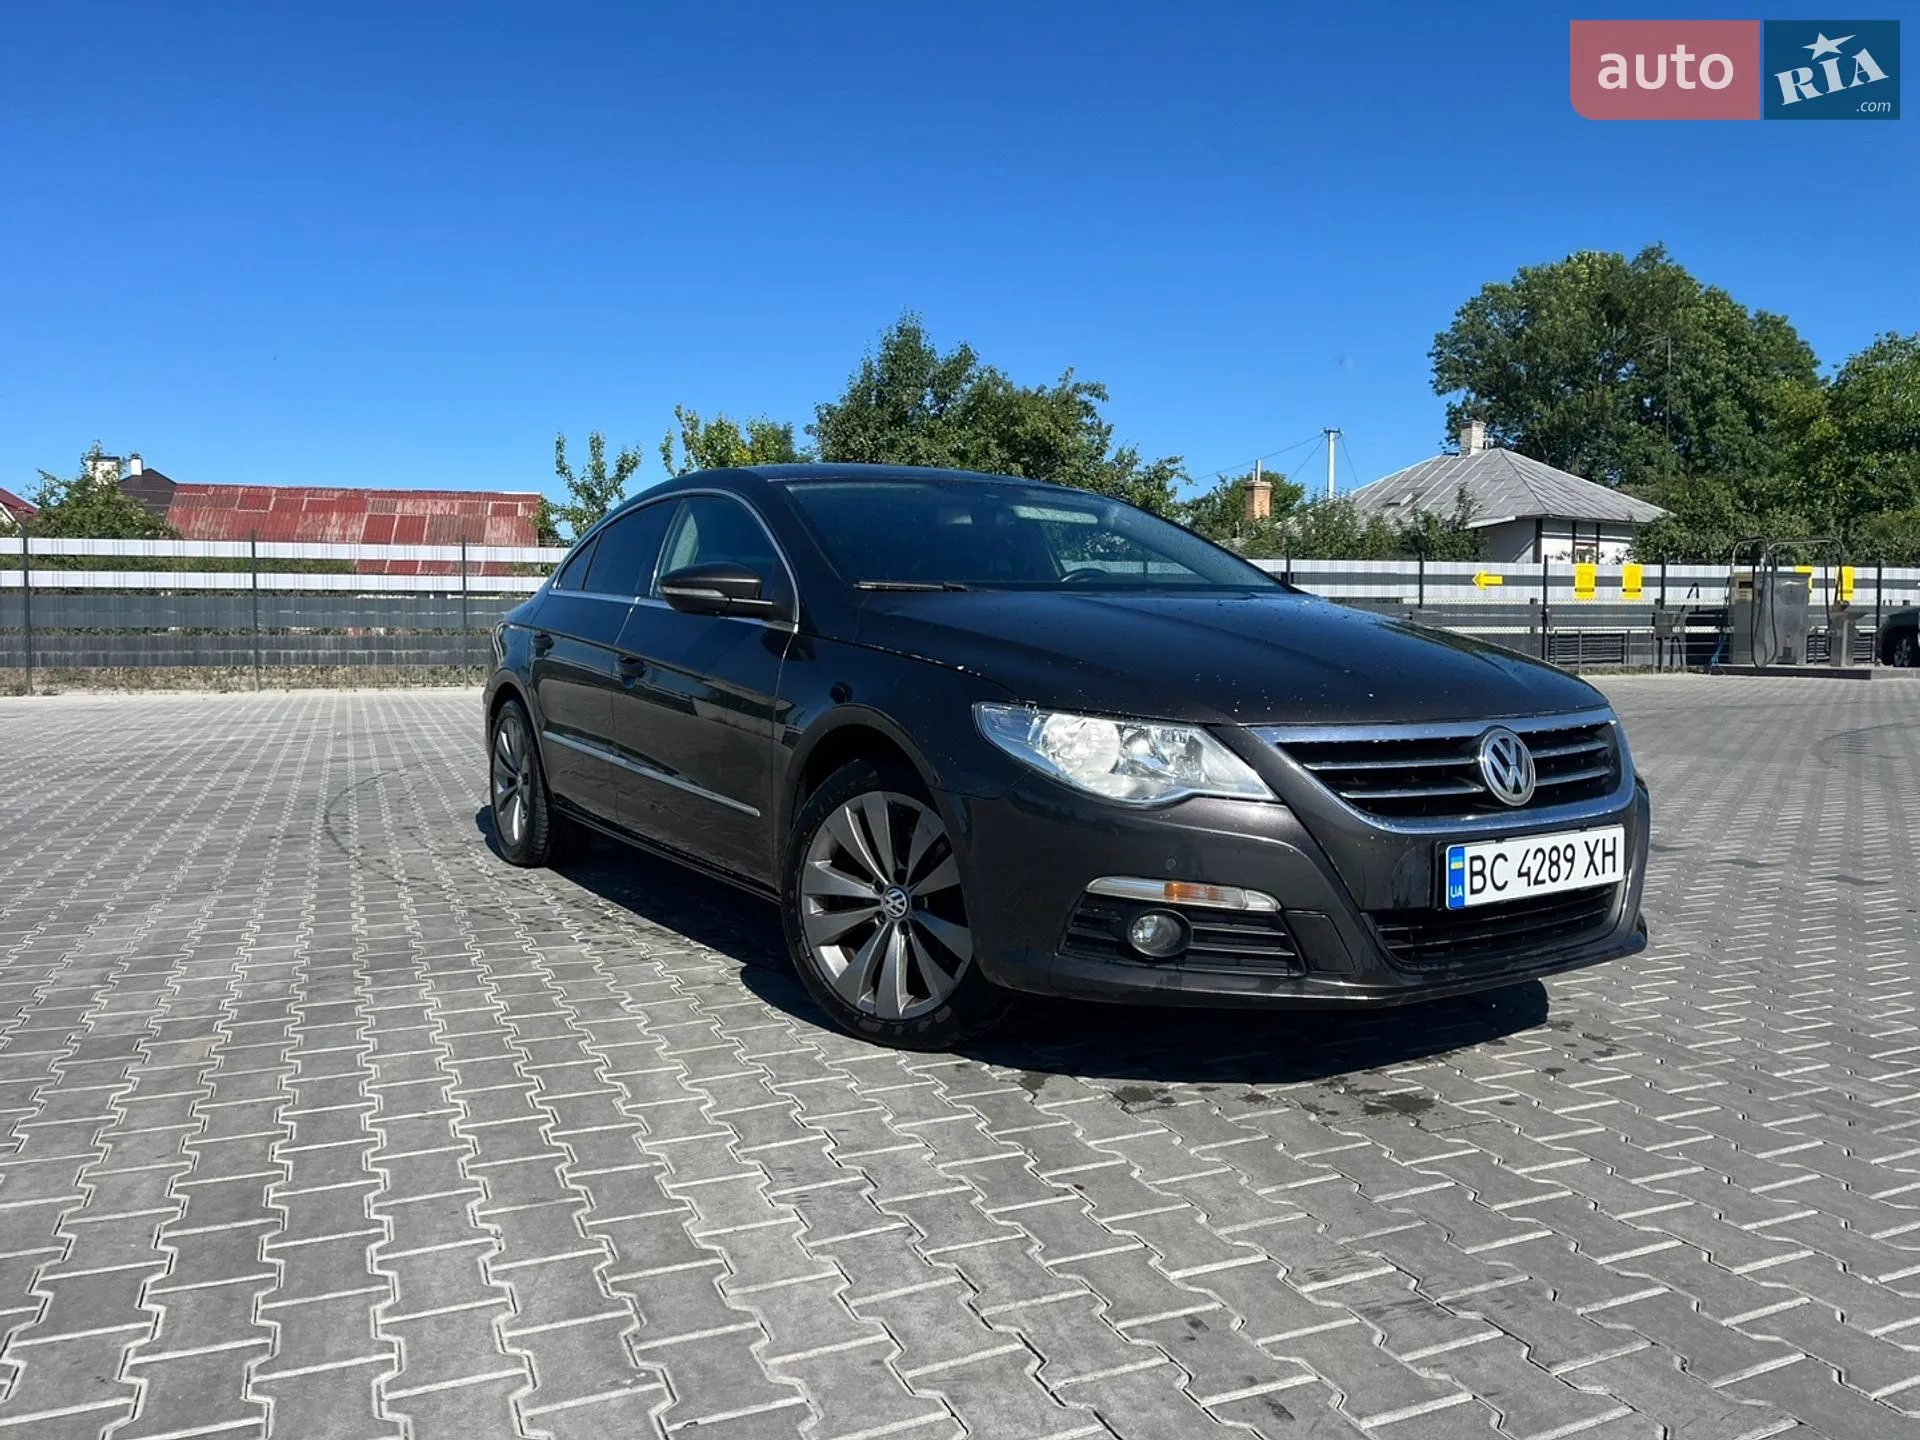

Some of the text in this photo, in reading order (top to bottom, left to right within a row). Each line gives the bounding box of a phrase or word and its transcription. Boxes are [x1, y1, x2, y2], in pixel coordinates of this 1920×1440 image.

[1469, 837, 1616, 895] BC 4289 XH
[1450, 886, 1463, 898] UA
